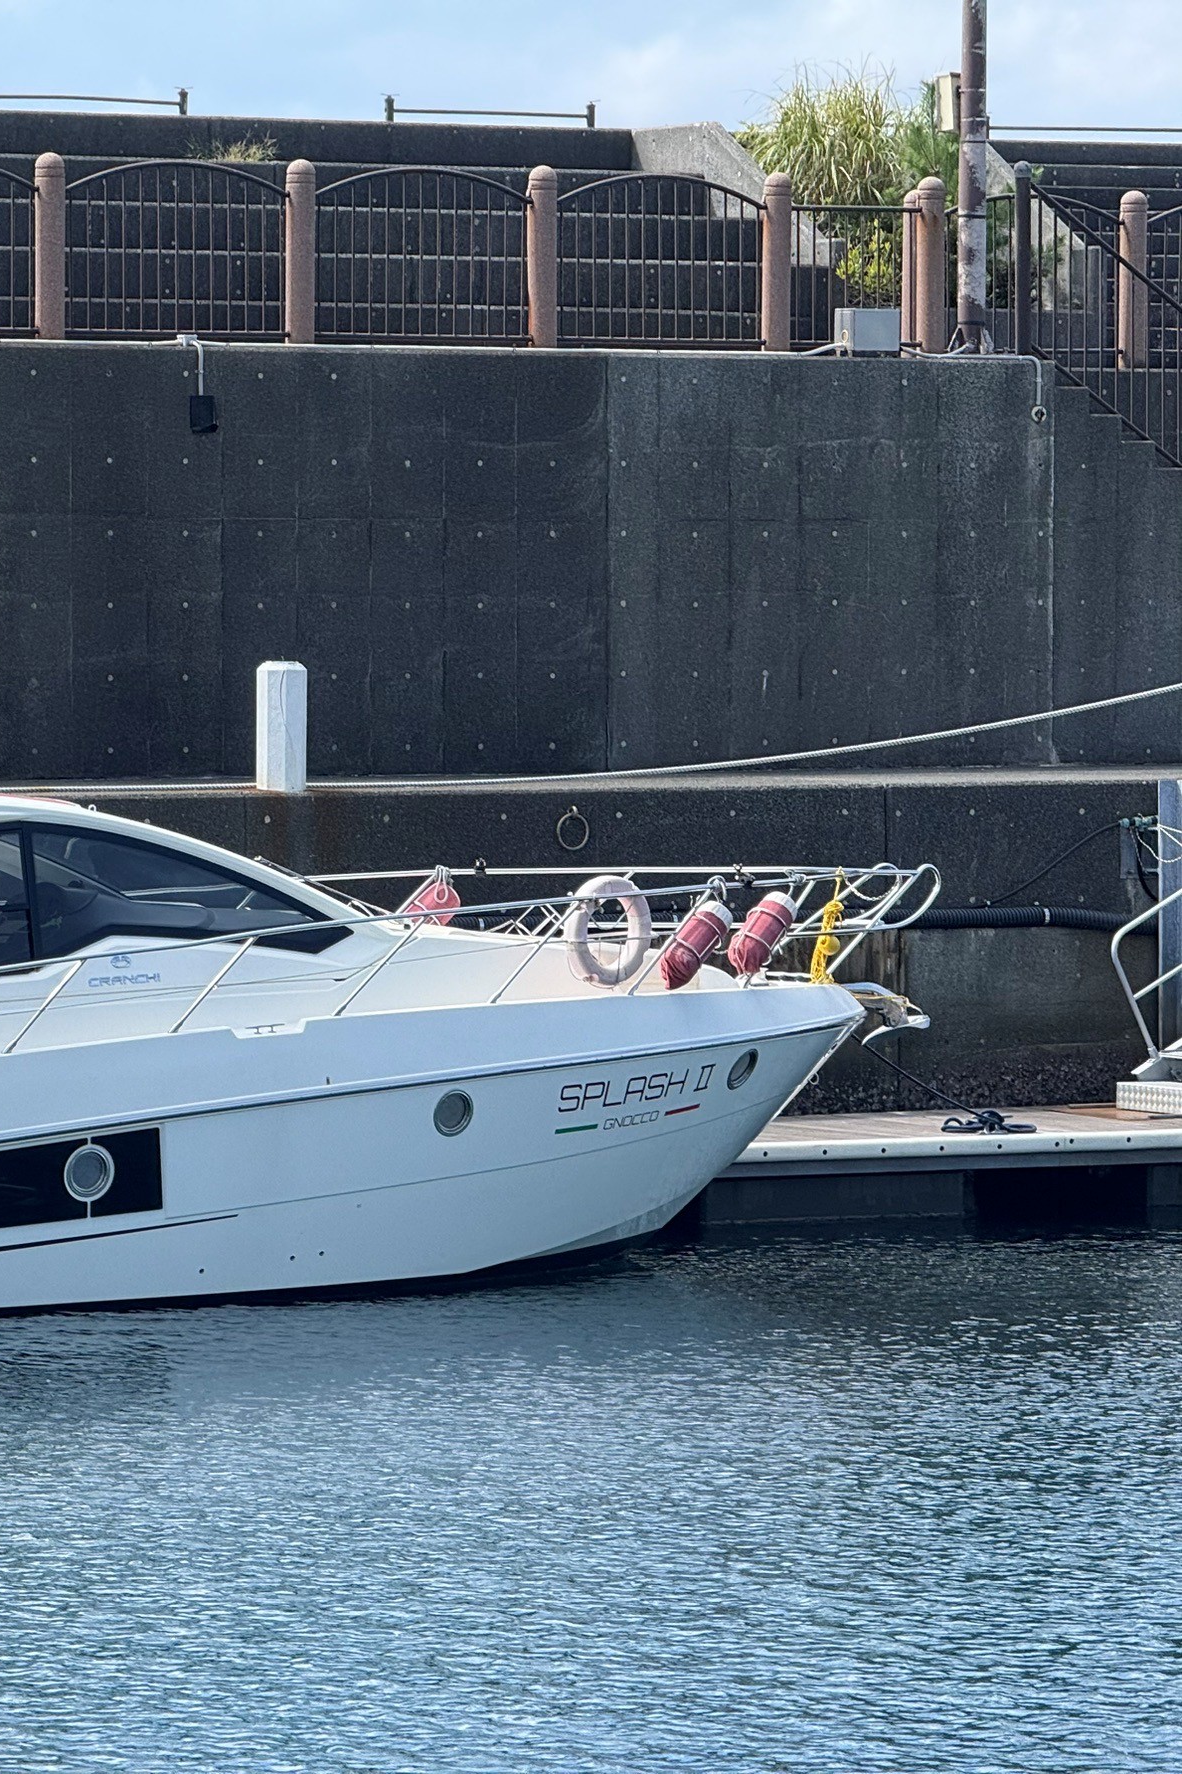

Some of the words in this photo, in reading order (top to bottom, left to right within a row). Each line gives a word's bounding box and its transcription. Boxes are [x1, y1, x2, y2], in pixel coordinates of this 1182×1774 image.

[88, 972, 161, 988] CRANCHI
[558, 1068, 690, 1113] SPLASH
[603, 1110, 660, 1130] GNOCCO
